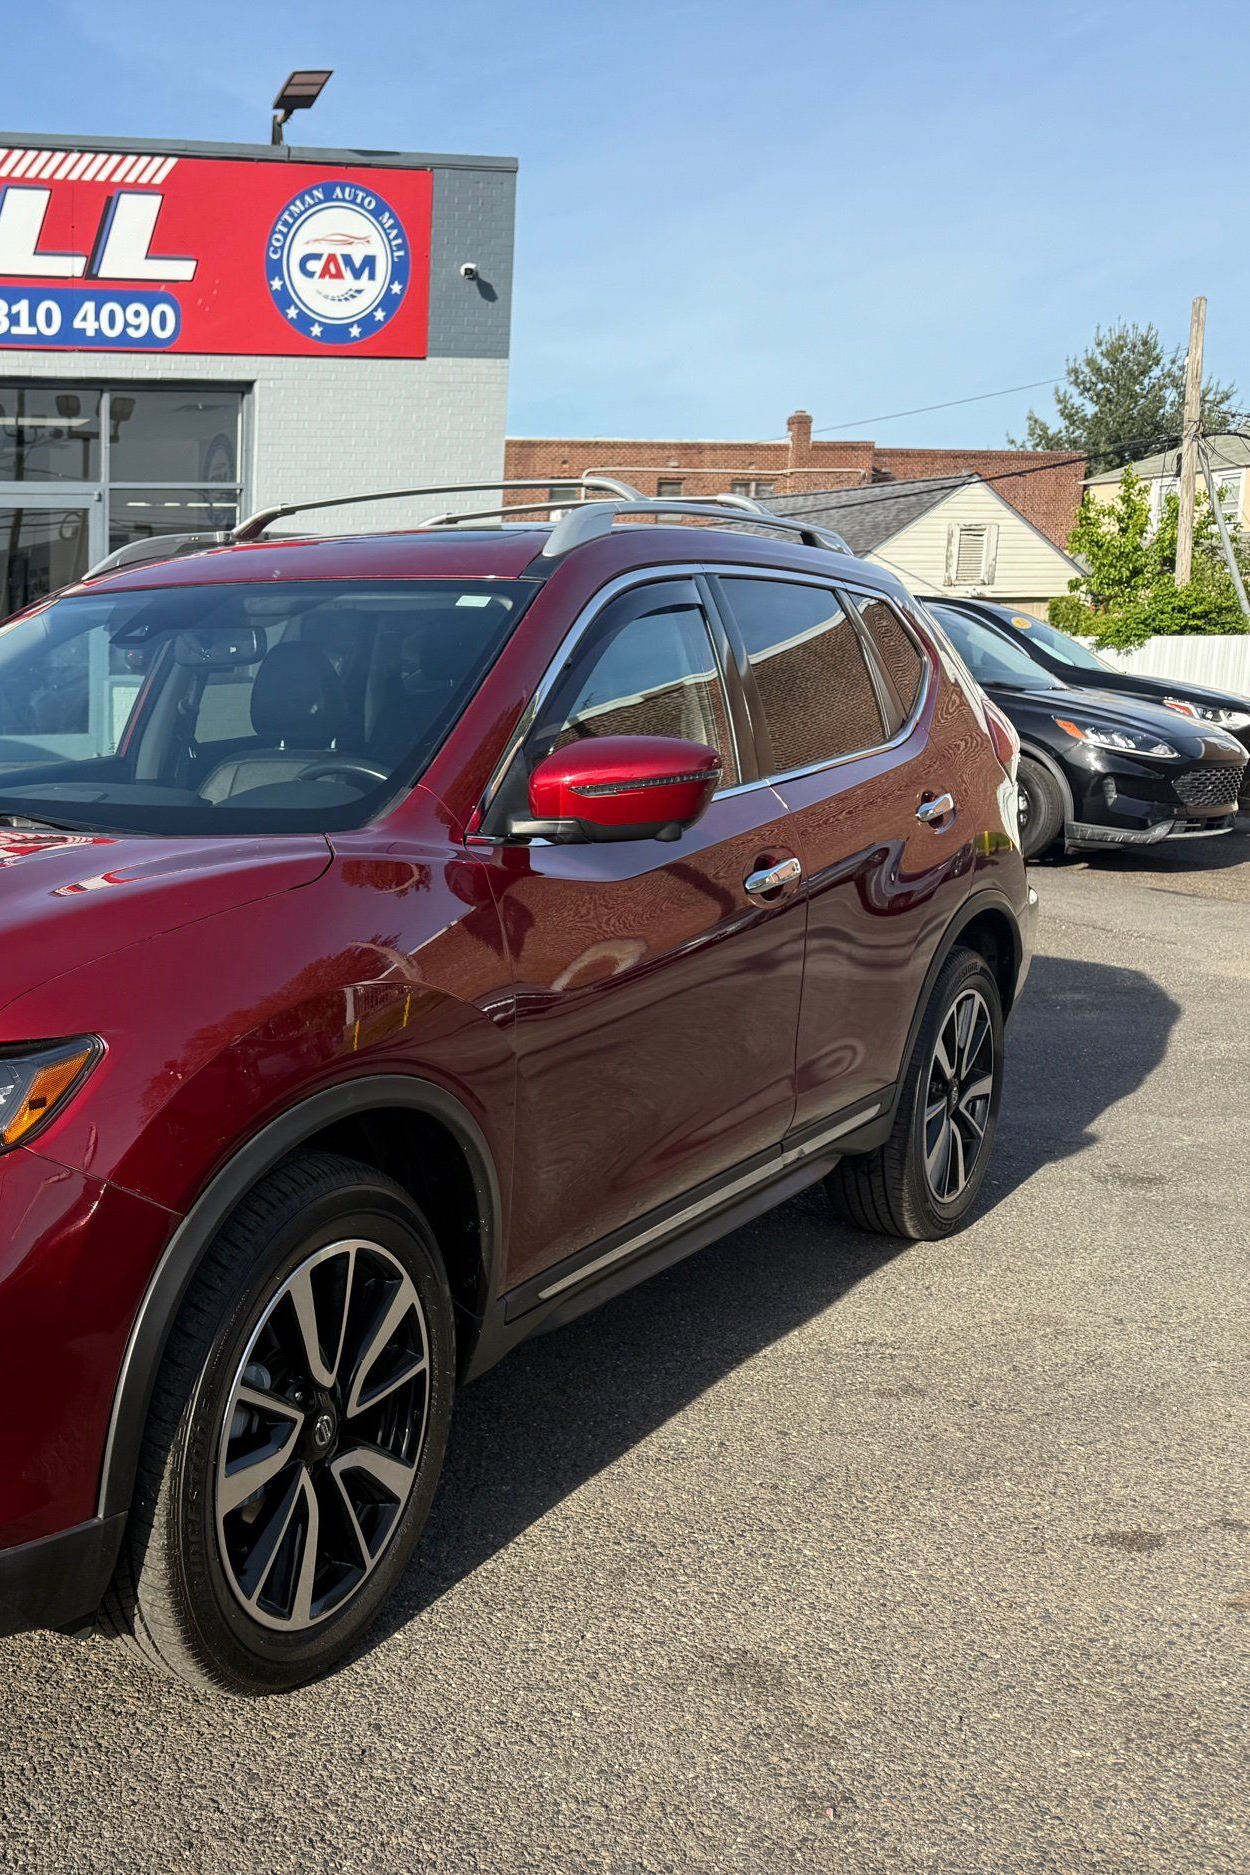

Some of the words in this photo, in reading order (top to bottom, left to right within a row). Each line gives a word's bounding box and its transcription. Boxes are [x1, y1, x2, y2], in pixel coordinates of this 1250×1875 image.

[268, 187, 325, 260] COTTMAN
[333, 186, 376, 211] AUTO
[379, 211, 406, 262] MALL
[298, 253, 377, 281] CAM
[73, 301, 176, 339] 4090
